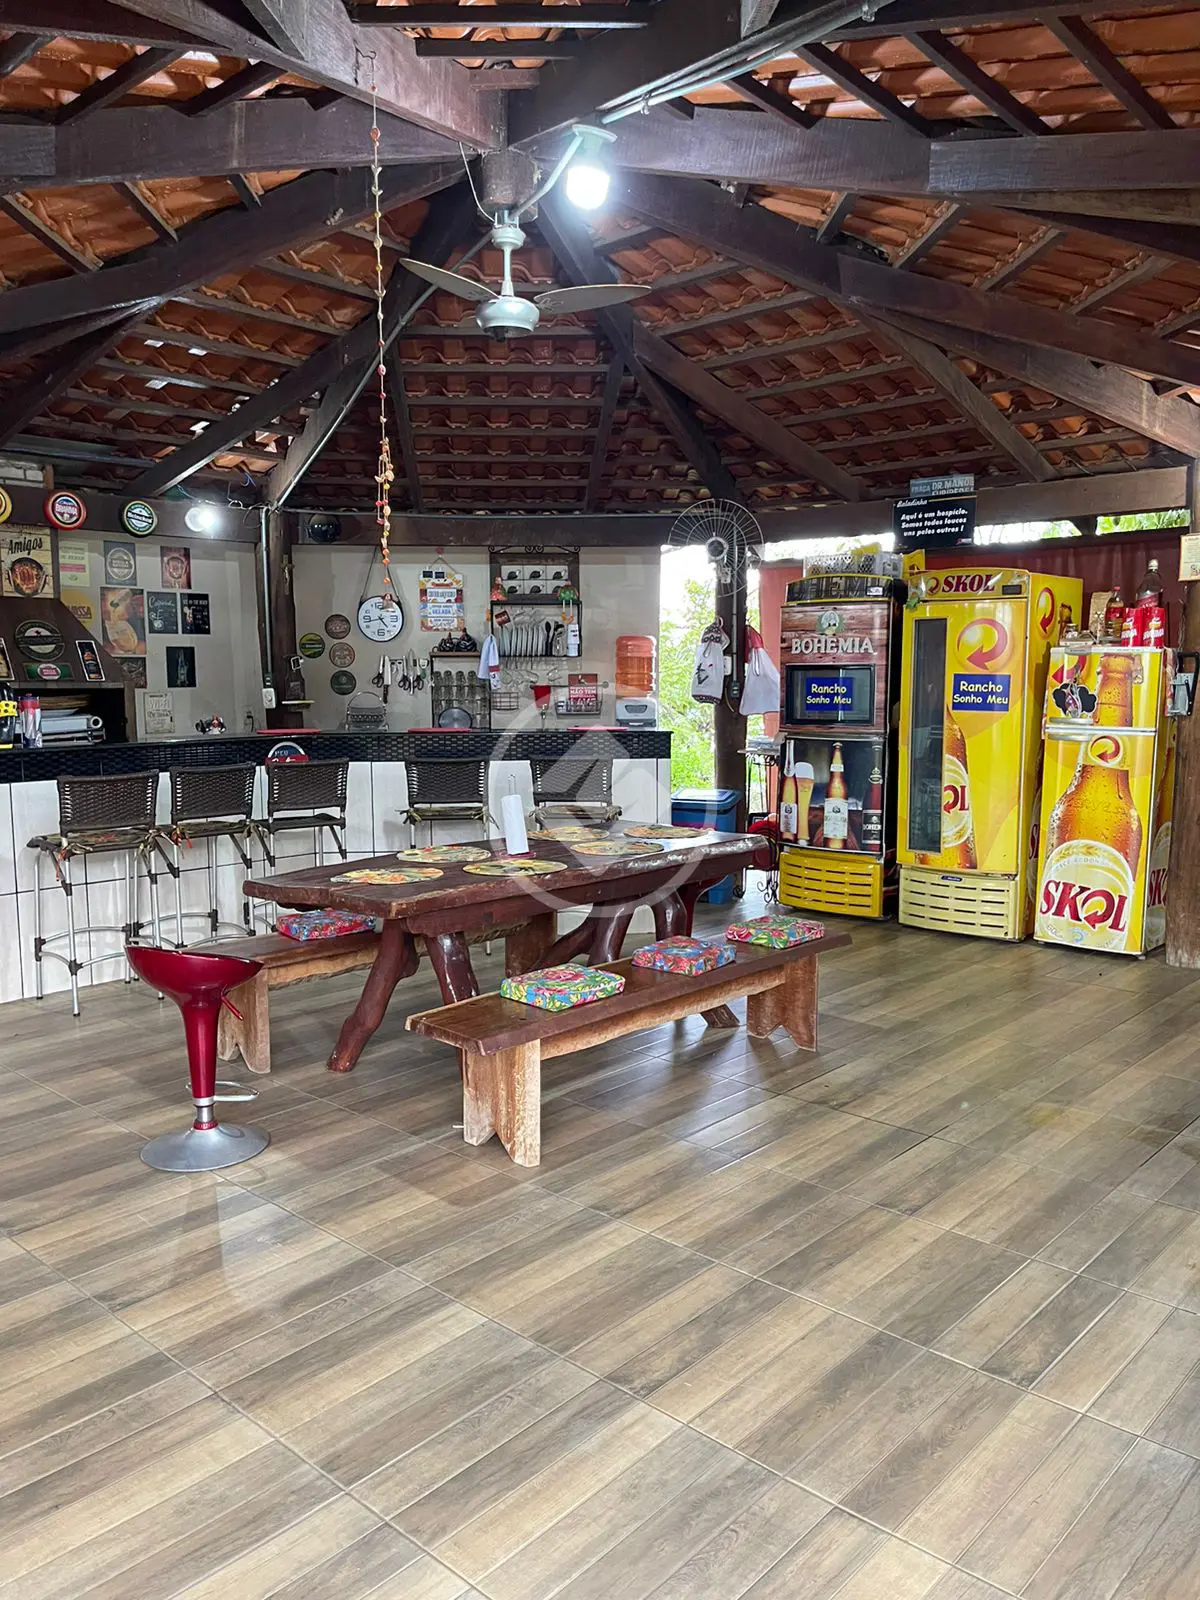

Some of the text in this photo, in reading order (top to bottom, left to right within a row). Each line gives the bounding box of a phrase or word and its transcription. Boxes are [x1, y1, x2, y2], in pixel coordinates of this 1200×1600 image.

[901, 512, 917, 521] Aqui
[901, 517, 967, 529] Somos todos loucos
[916, 528, 935, 536] pelos
[936, 526, 959, 534] outros
[8, 536, 43, 556] Amigos
[941, 574, 995, 593] SKOL
[791, 637, 874, 654] BOHEMIA
[811, 683, 847, 694] Rancho
[960, 681, 1003, 693] Rancho
[806, 696, 852, 704] Sonho Meu
[953, 694, 1008, 704] Sonho Meu
[1039, 879, 1128, 932] SKOL
